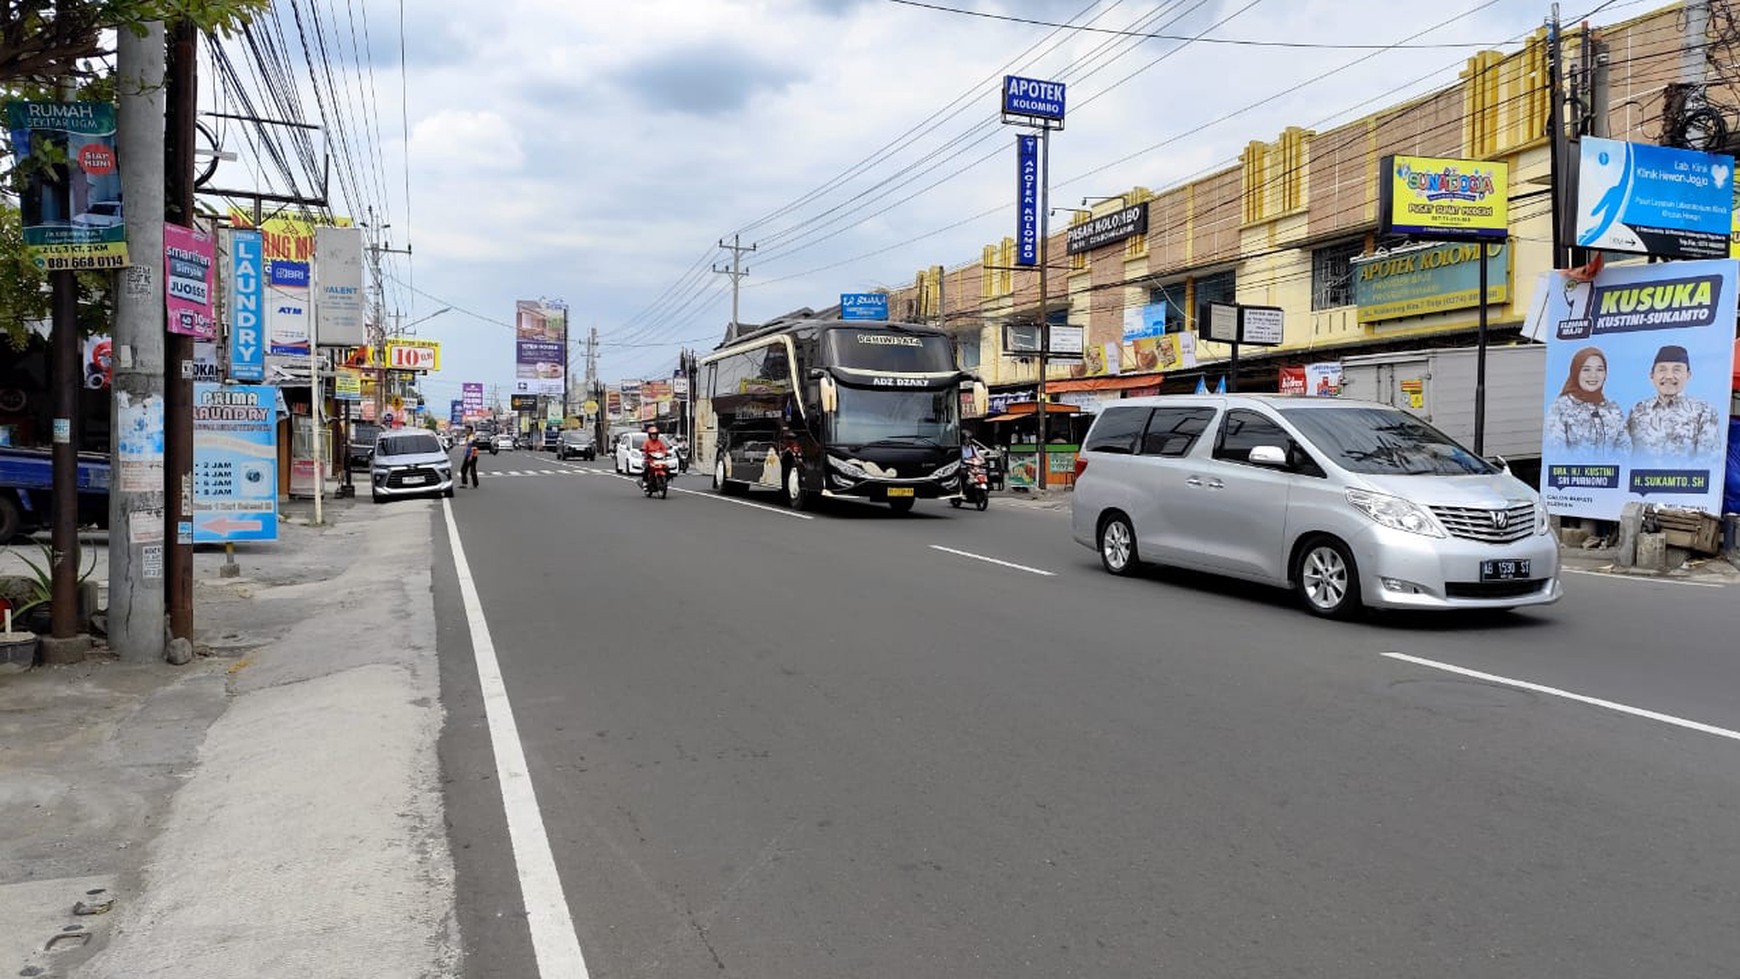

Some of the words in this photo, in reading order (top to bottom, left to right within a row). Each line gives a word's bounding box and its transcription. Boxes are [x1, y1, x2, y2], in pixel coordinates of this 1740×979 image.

[1009, 78, 1063, 102] APOTEK
[28, 103, 93, 118] RUMAH
[1013, 98, 1059, 113] KOLOMBO
[27, 117, 68, 127] SEKITAR
[71, 119, 98, 129] UGM
[85, 151, 110, 160] SIAP
[84, 160, 111, 168] HUNI
[1024, 160, 1034, 203] APOTEK
[1637, 167, 1658, 179] Klinik
[1660, 170, 1685, 182] Hewan
[1686, 174, 1708, 187] Jogja
[1408, 203, 1433, 214] PUSAT
[1435, 204, 1460, 215] SUNAT
[1461, 206, 1493, 216] MODERN
[1024, 207, 1034, 258] KOLOMBO
[1068, 222, 1094, 243] PASAR
[95, 244, 109, 252] KM
[166, 245, 211, 266] smartfren
[48, 257, 69, 269] 081
[71, 257, 95, 268] 668
[98, 255, 124, 267] 0114
[1360, 255, 1417, 281] APOTEK
[1420, 241, 1502, 271] KOLOMO
[288, 269, 304, 280] BRI
[236, 242, 257, 362] LAUNDRY
[1565, 281, 1594, 320] 1
[1600, 281, 1712, 315] KUSUKA
[278, 306, 303, 315] ATM
[1597, 308, 1709, 329] KUSTINI-SUKAMTO
[1561, 328, 1583, 336] MAJU
[397, 349, 419, 366] 10
[874, 378, 894, 386] ADZ
[201, 391, 258, 406] PRIMA
[193, 406, 268, 421] LAUNDRY
[1585, 467, 1615, 476] KUSTINI
[1558, 476, 1570, 485] SRI
[1571, 477, 1608, 486] PURNOMO
[1634, 475, 1643, 487] H.
[1692, 476, 1705, 488] SH
[1485, 562, 1494, 575] AB
[1499, 561, 1516, 574] 1530
